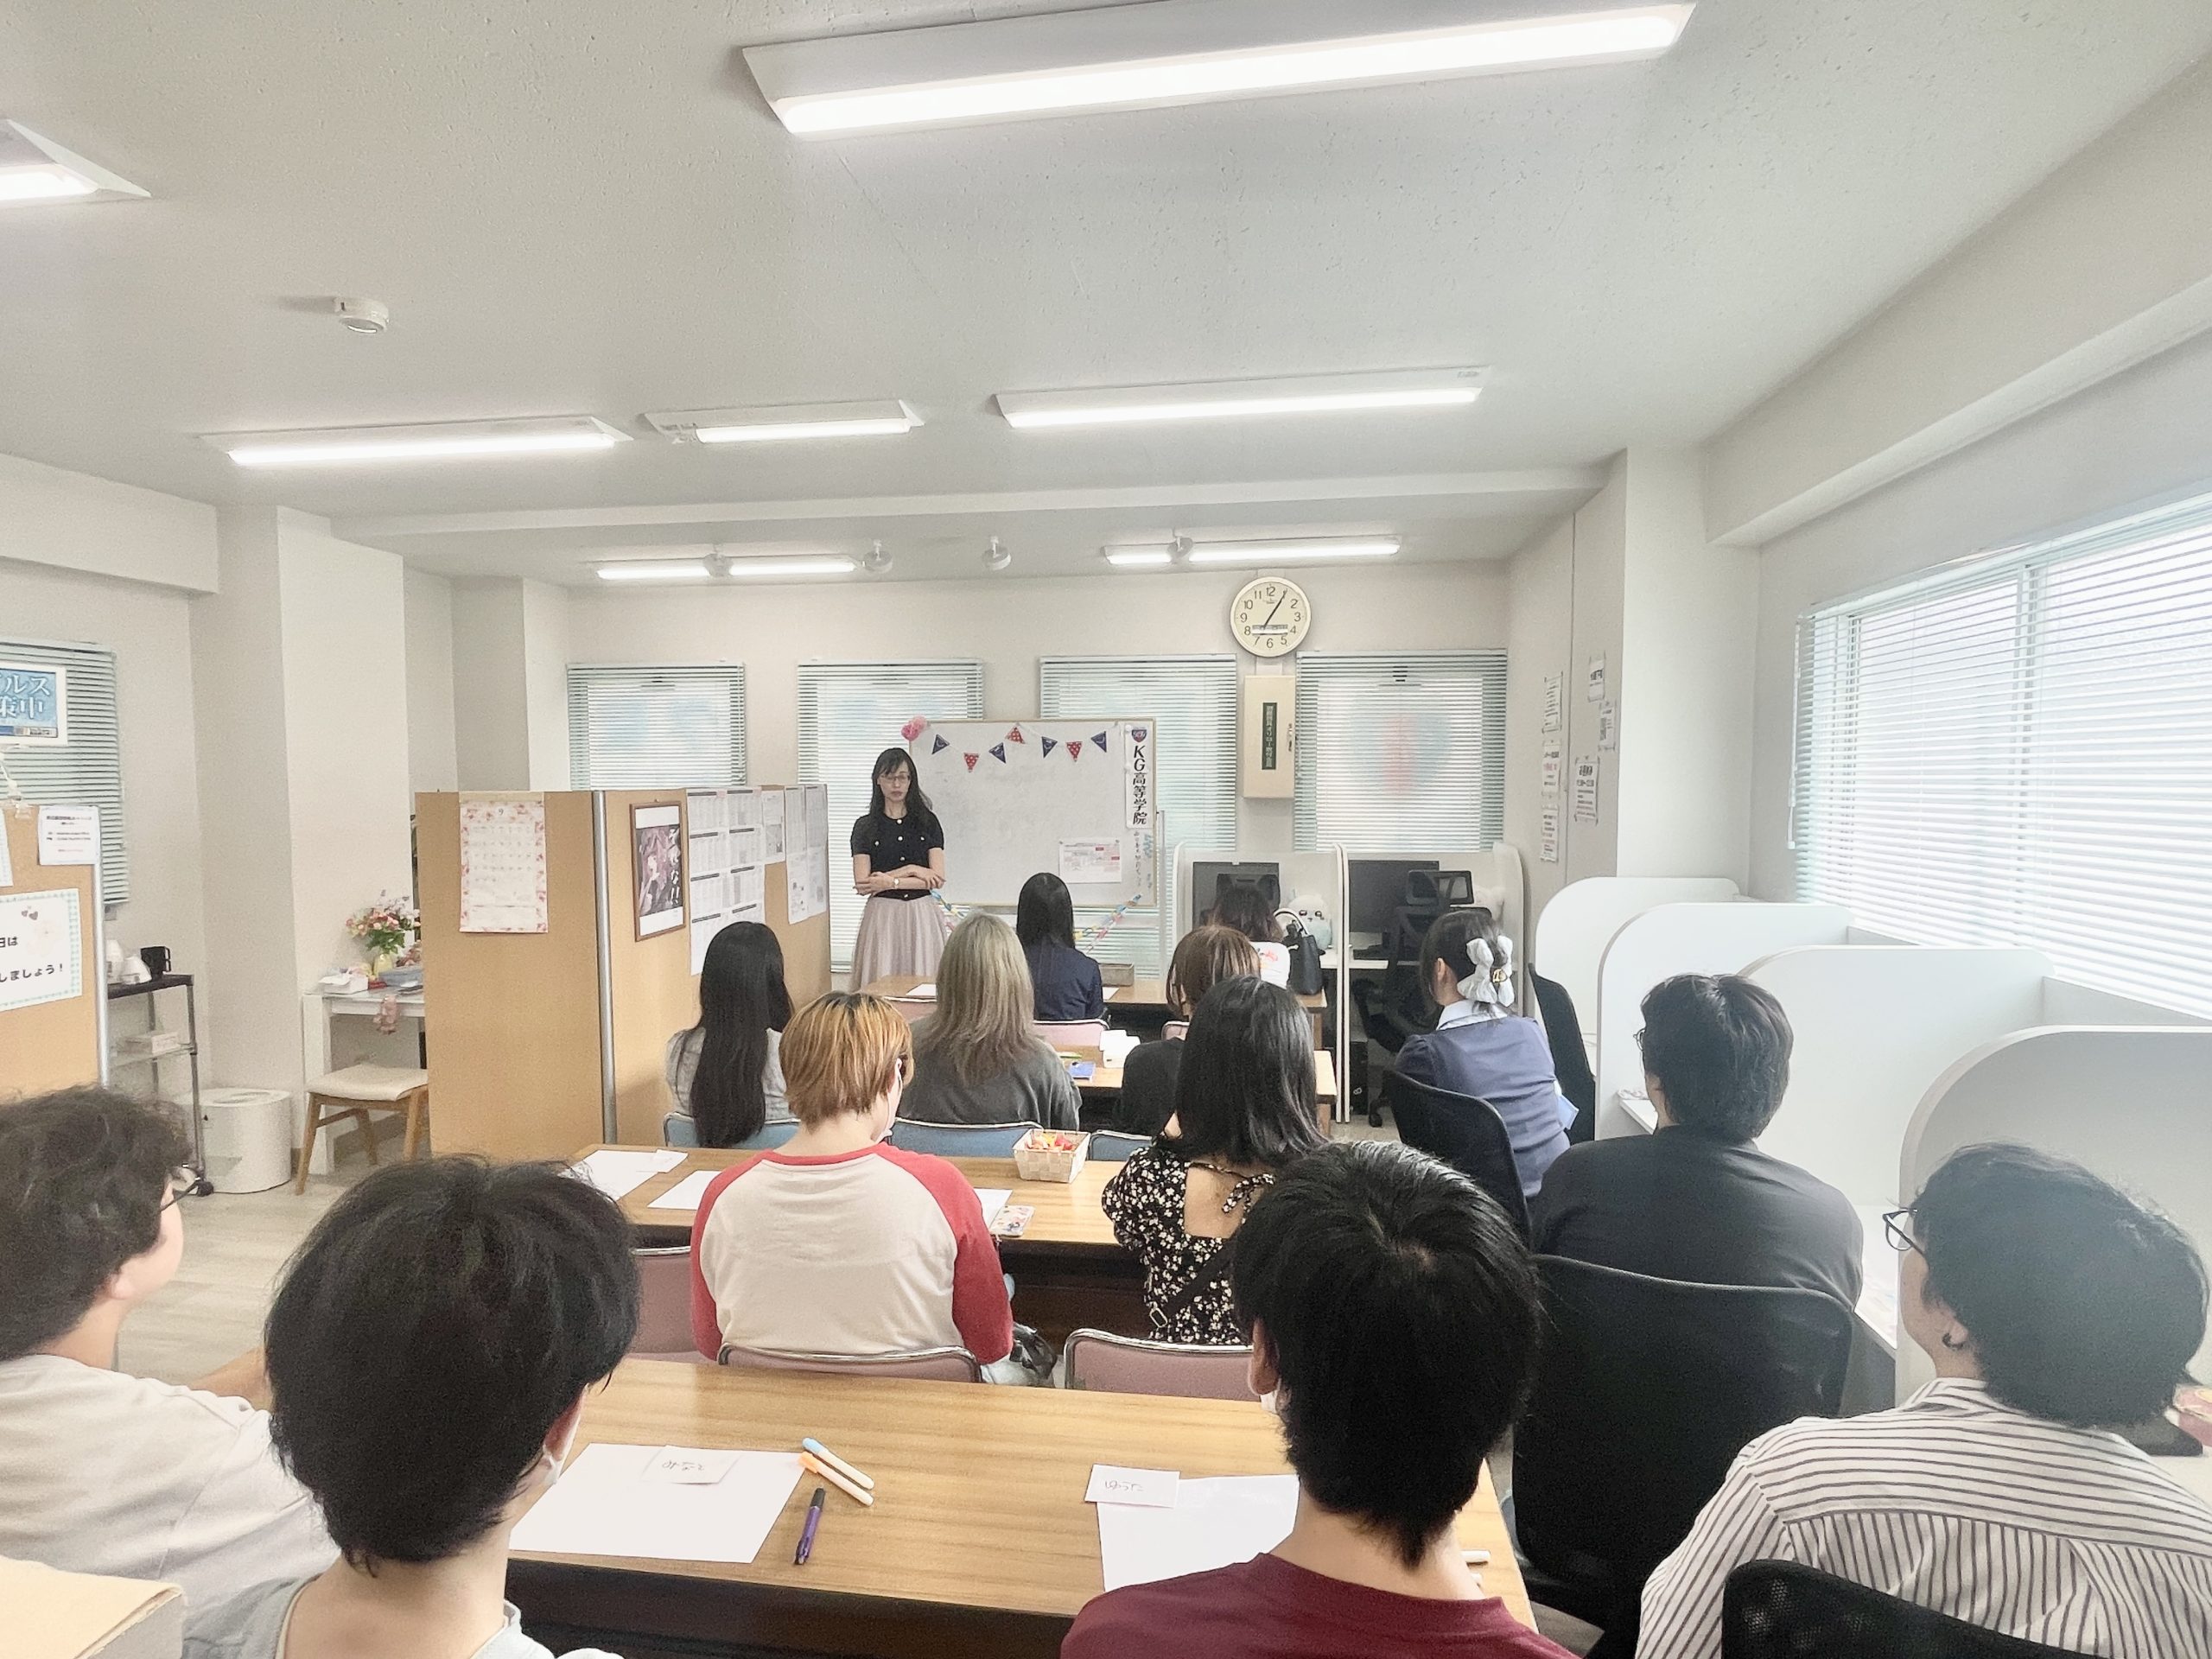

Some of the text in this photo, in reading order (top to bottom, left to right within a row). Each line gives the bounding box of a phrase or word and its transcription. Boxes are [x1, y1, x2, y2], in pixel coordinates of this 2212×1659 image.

[1254, 590, 1262, 599] 11
[1266, 587, 1275, 596] 12
[1244, 599, 1253, 609] 10
[1290, 598, 1298, 608] 2
[1240, 613, 1248, 622] 9
[1294, 612, 1301, 621] 3
[1243, 626, 1251, 635] 8
[1266, 638, 1274, 648] 6
[1281, 635, 1287, 645] 5
[0, 675, 50, 696] ルス
[1133, 745, 1148, 825] KG高等学院
